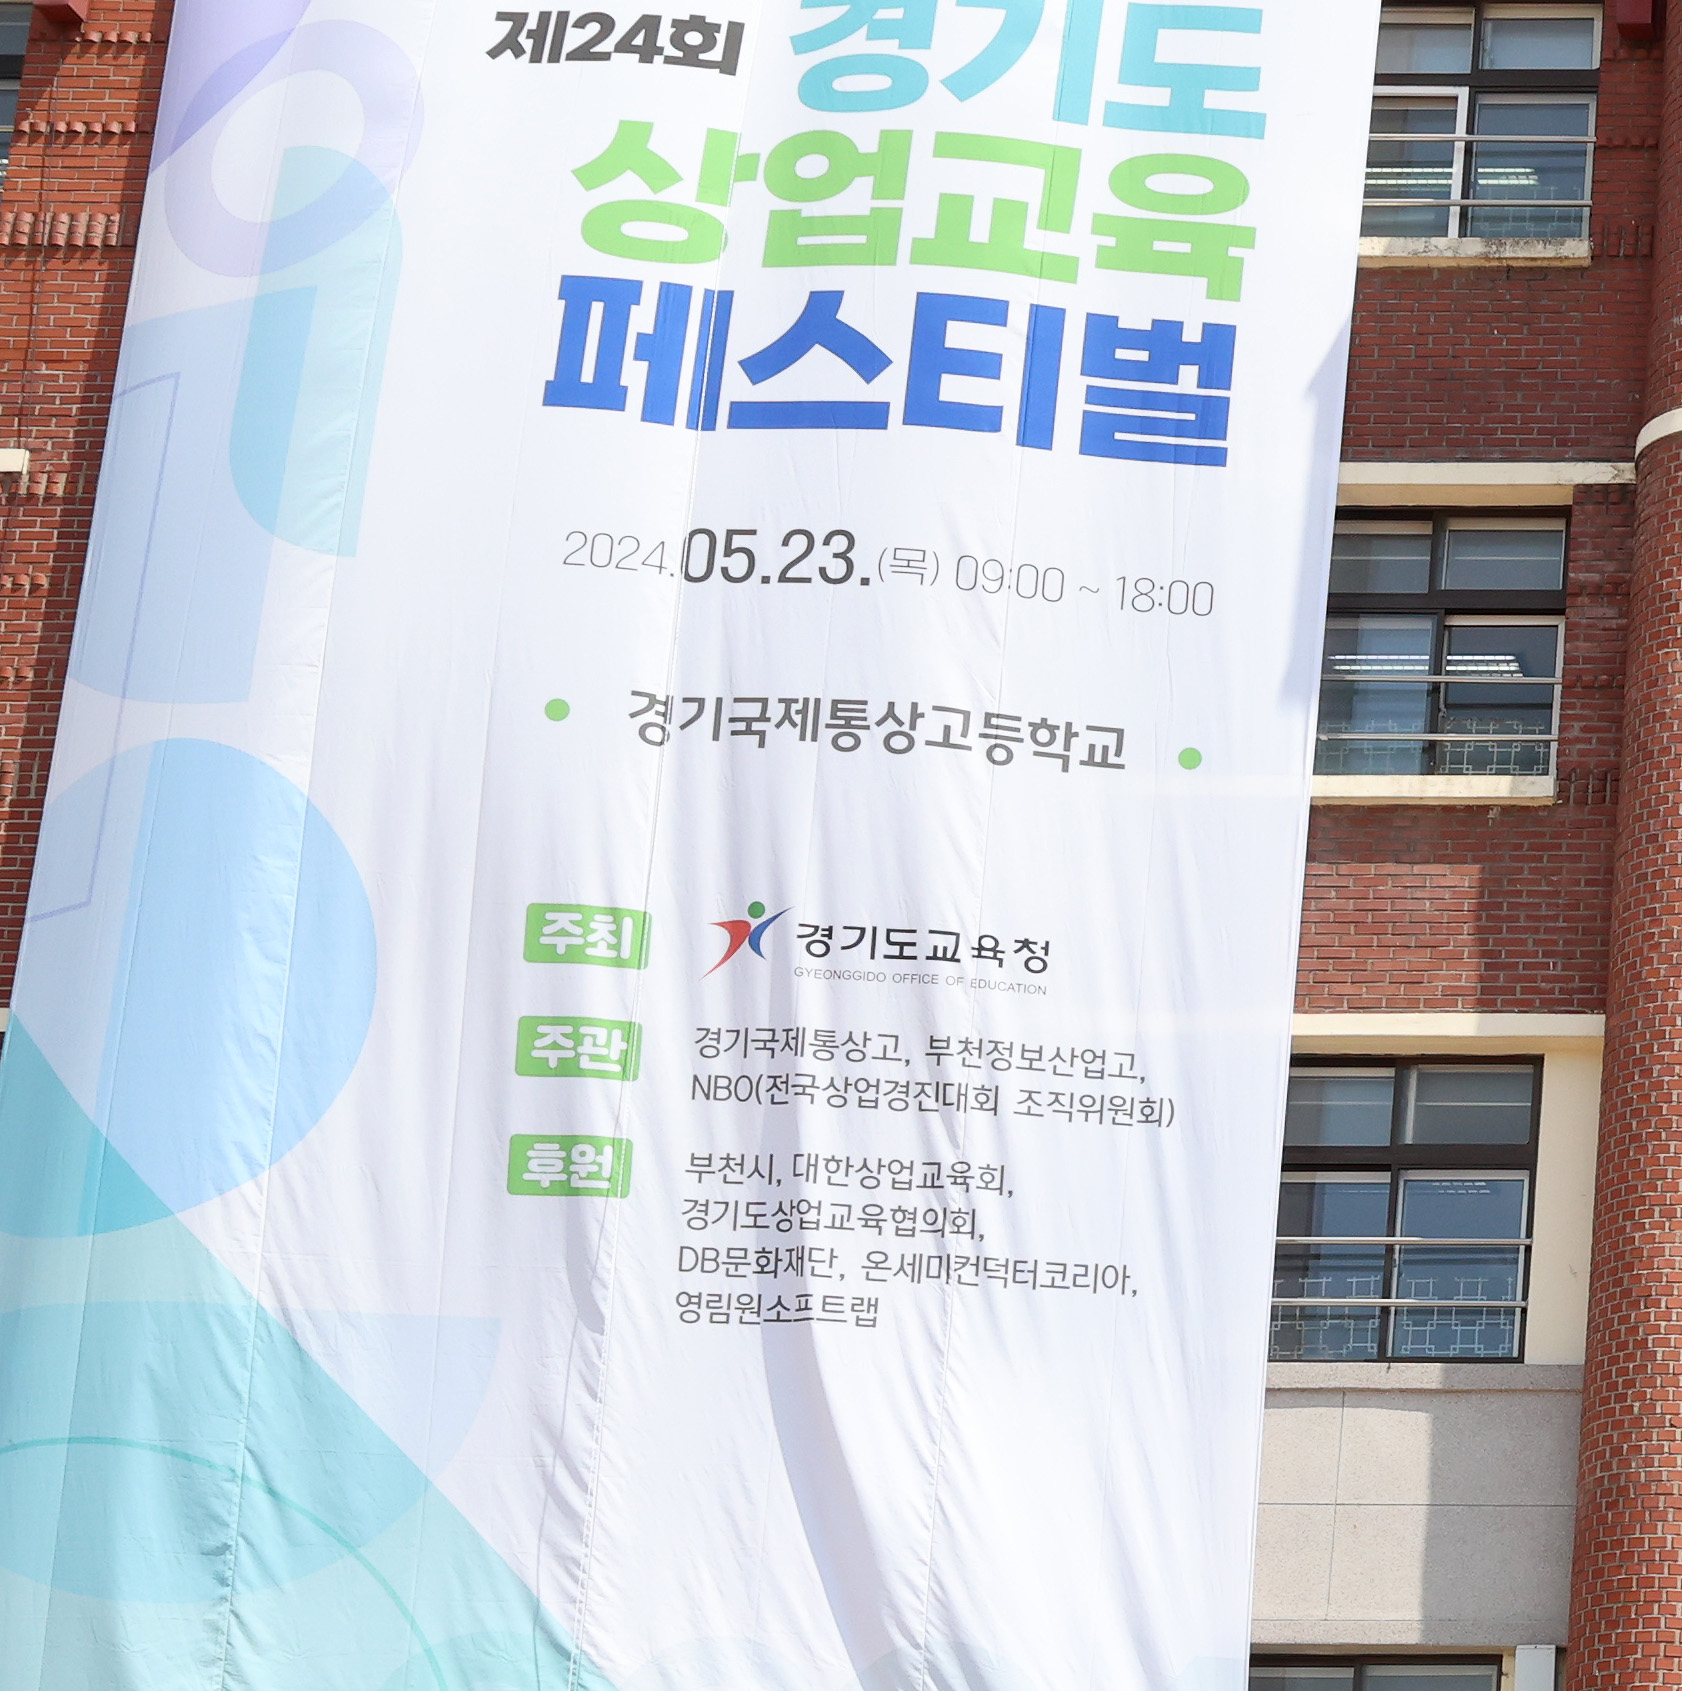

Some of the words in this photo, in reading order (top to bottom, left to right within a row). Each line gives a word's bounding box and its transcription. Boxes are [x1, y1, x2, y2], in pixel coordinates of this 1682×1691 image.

[485, 9, 746, 76] 제24회
[789, 0, 1266, 140] 경기도
[570, 119, 1257, 303] 상업교육
[542, 274, 1236, 467] 페스티벌
[955, 554, 1065, 603] 09:00
[1116, 575, 1214, 617] 18:00
[628, 689, 1126, 773] 경기국제통상고등학교
[538, 908, 633, 961] 주최
[796, 922, 1051, 974] 경기도교육청
[793, 966, 887, 983] GYEONGGIDO
[892, 972, 940, 985] OFFICE
[945, 975, 965, 987] OF
[970, 978, 1048, 996] EDUCATION
[531, 1023, 627, 1075] 주관
[693, 1025, 911, 1067] 경기국제통상고,
[923, 1034, 1147, 1084] 부천정보산업고,
[689, 1071, 999, 1118] NBO(전국상업경진대회
[1012, 1086, 1176, 1130] 조직위원회)
[521, 1141, 615, 1191] 후원
[684, 1150, 783, 1190] 부천시,
[791, 1154, 1014, 1198] 대한상업교육회,
[680, 1197, 985, 1242] 경기도상업교육협의회,
[677, 1244, 846, 1282] DB문화재단,
[859, 1250, 1138, 1298] 온세미컨덕터코리아,
[674, 1290, 880, 1328] 영림원소프트랩
